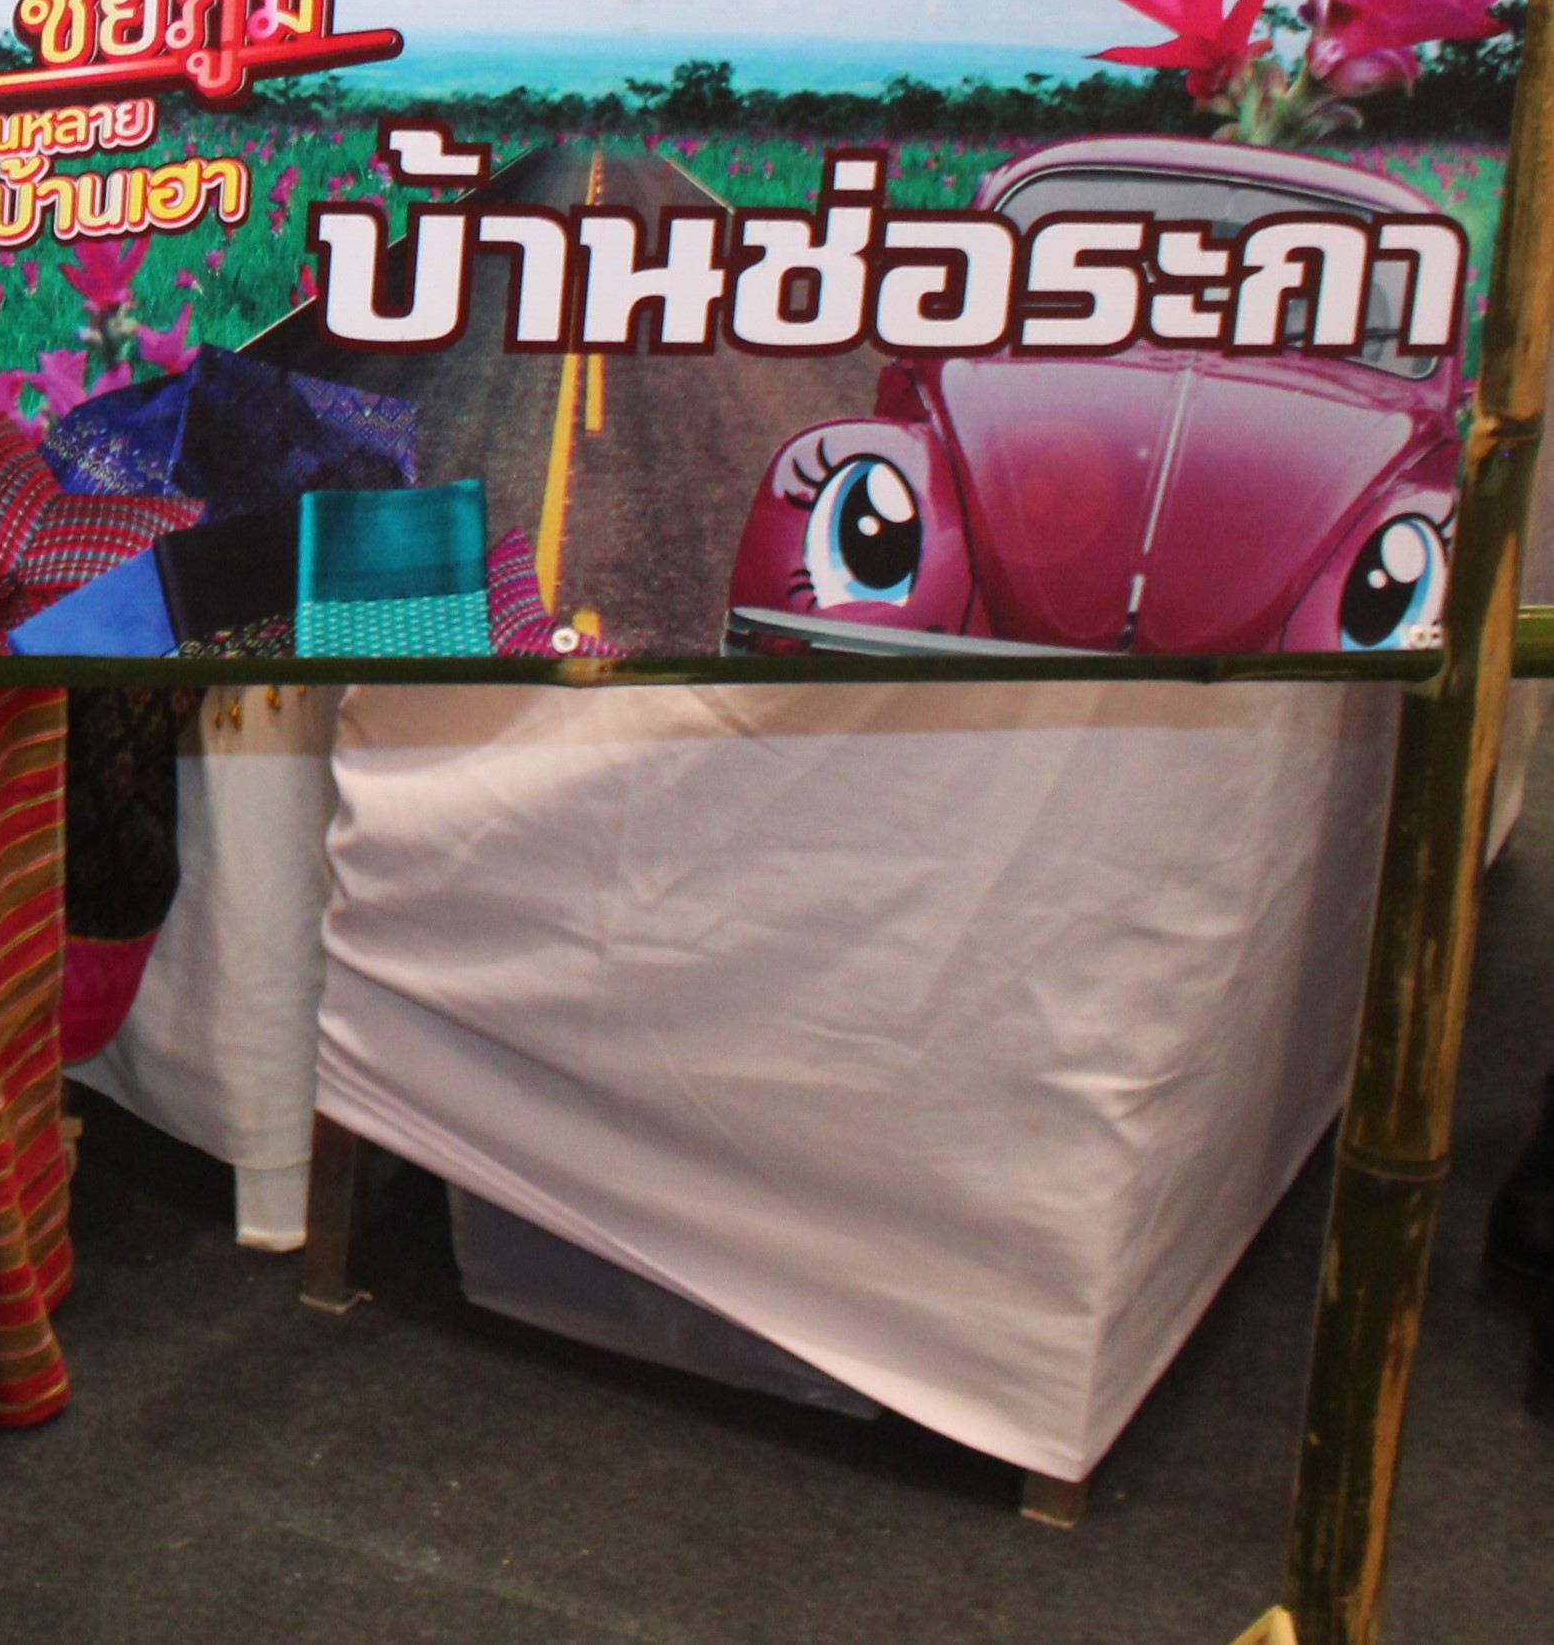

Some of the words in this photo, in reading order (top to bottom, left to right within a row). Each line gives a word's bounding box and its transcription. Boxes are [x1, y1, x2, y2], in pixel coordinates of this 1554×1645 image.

[312, 120, 1468, 354] บ้านช่อระกา
